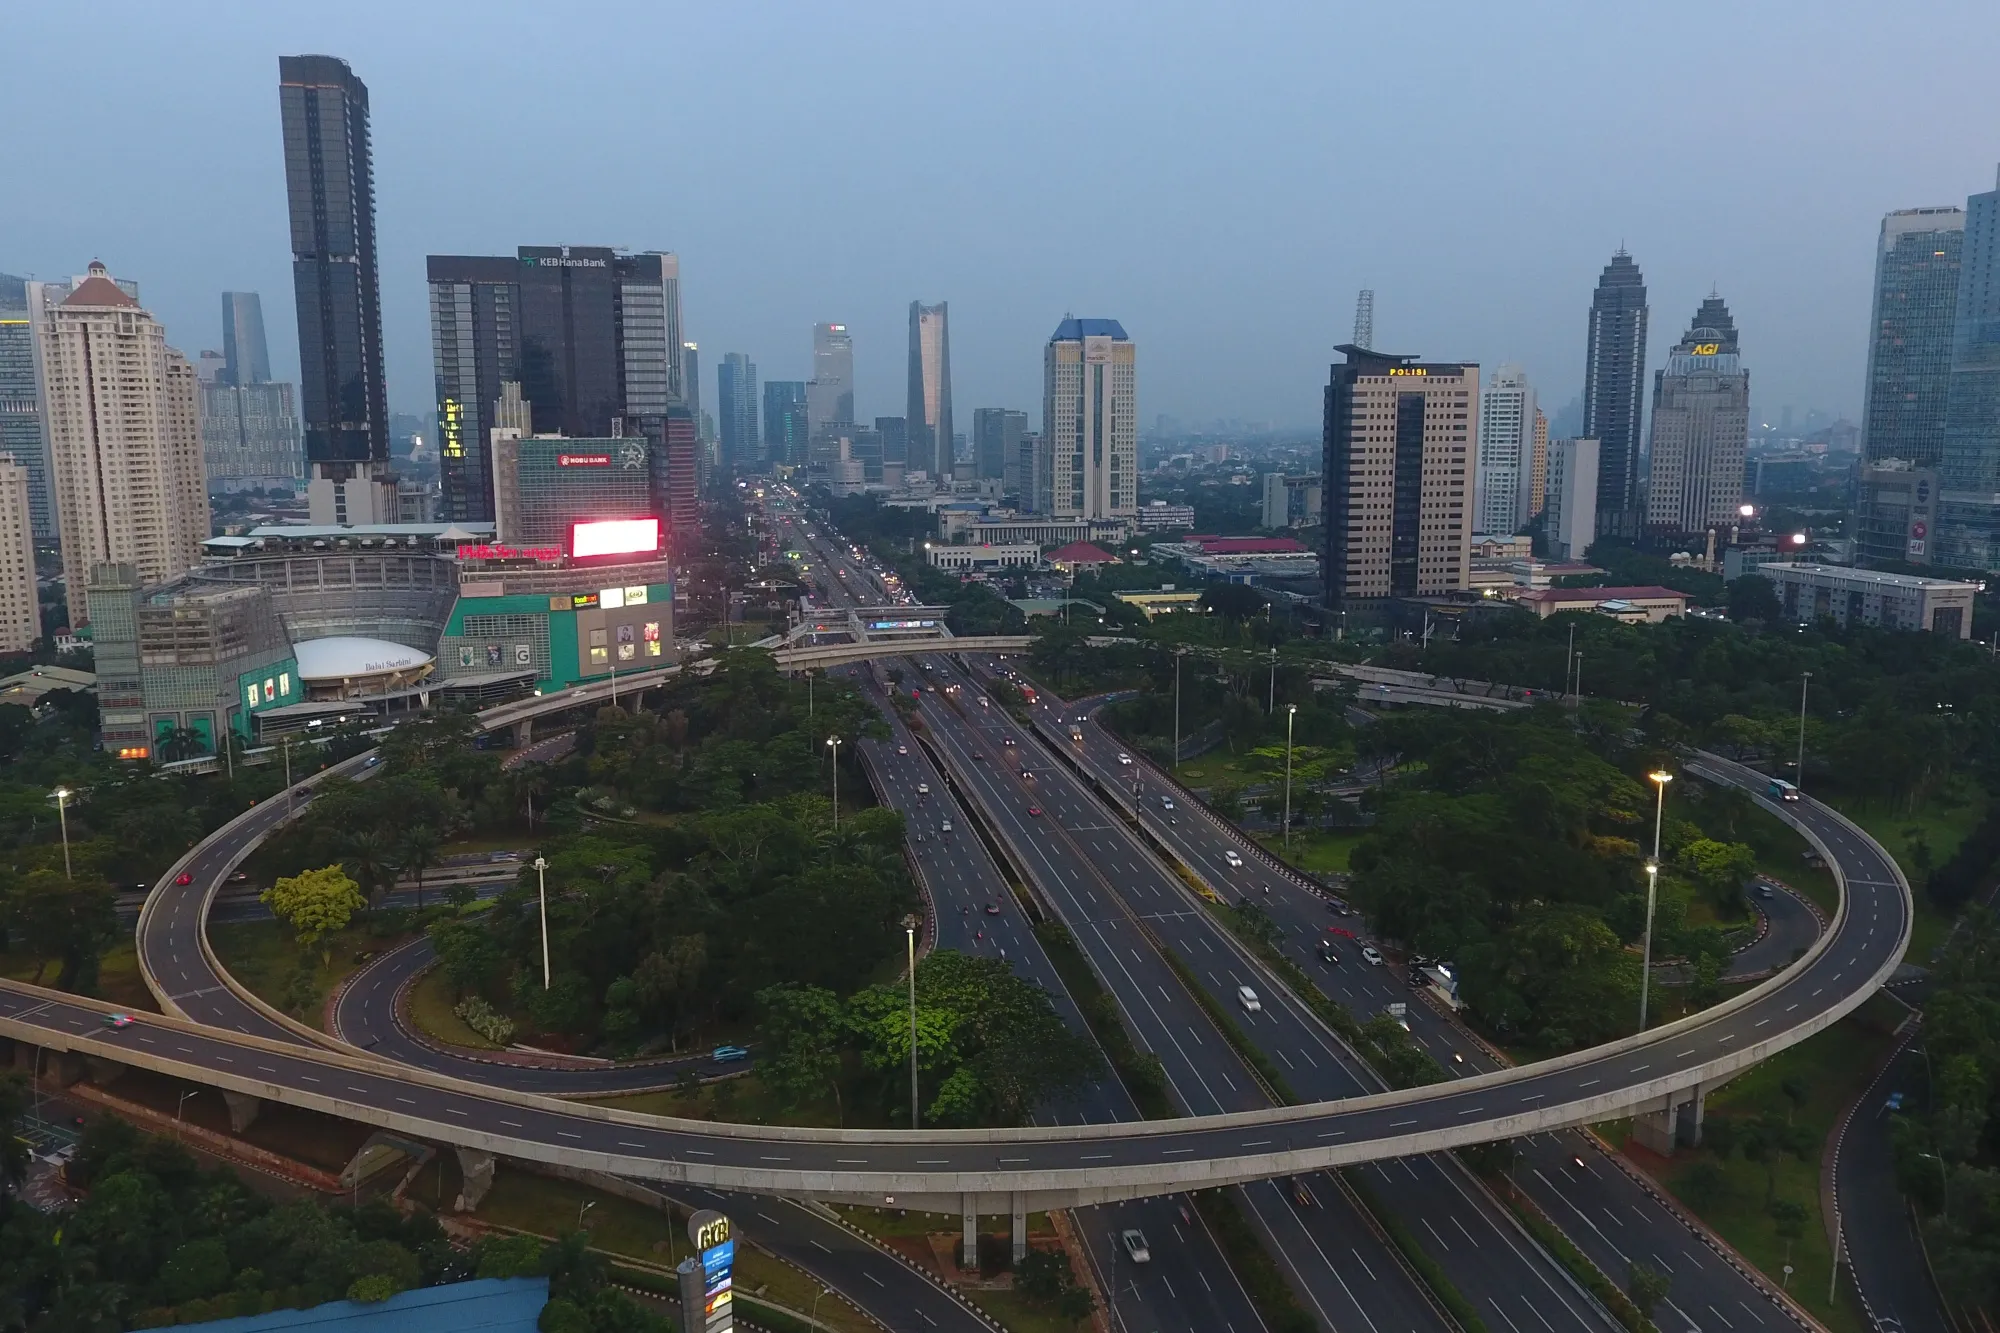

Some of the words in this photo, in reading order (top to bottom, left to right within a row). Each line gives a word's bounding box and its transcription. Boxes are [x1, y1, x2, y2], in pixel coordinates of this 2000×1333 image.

[540, 257, 558, 267] KEB
[559, 258, 582, 267] Hana
[583, 259, 606, 267] Bank
[1691, 343, 1719, 356] AGI
[1390, 368, 1427, 376] POLISI
[365, 661, 385, 671] Balai
[386, 657, 412, 668] Sarbini
[698, 1217, 730, 1250] GKBI
